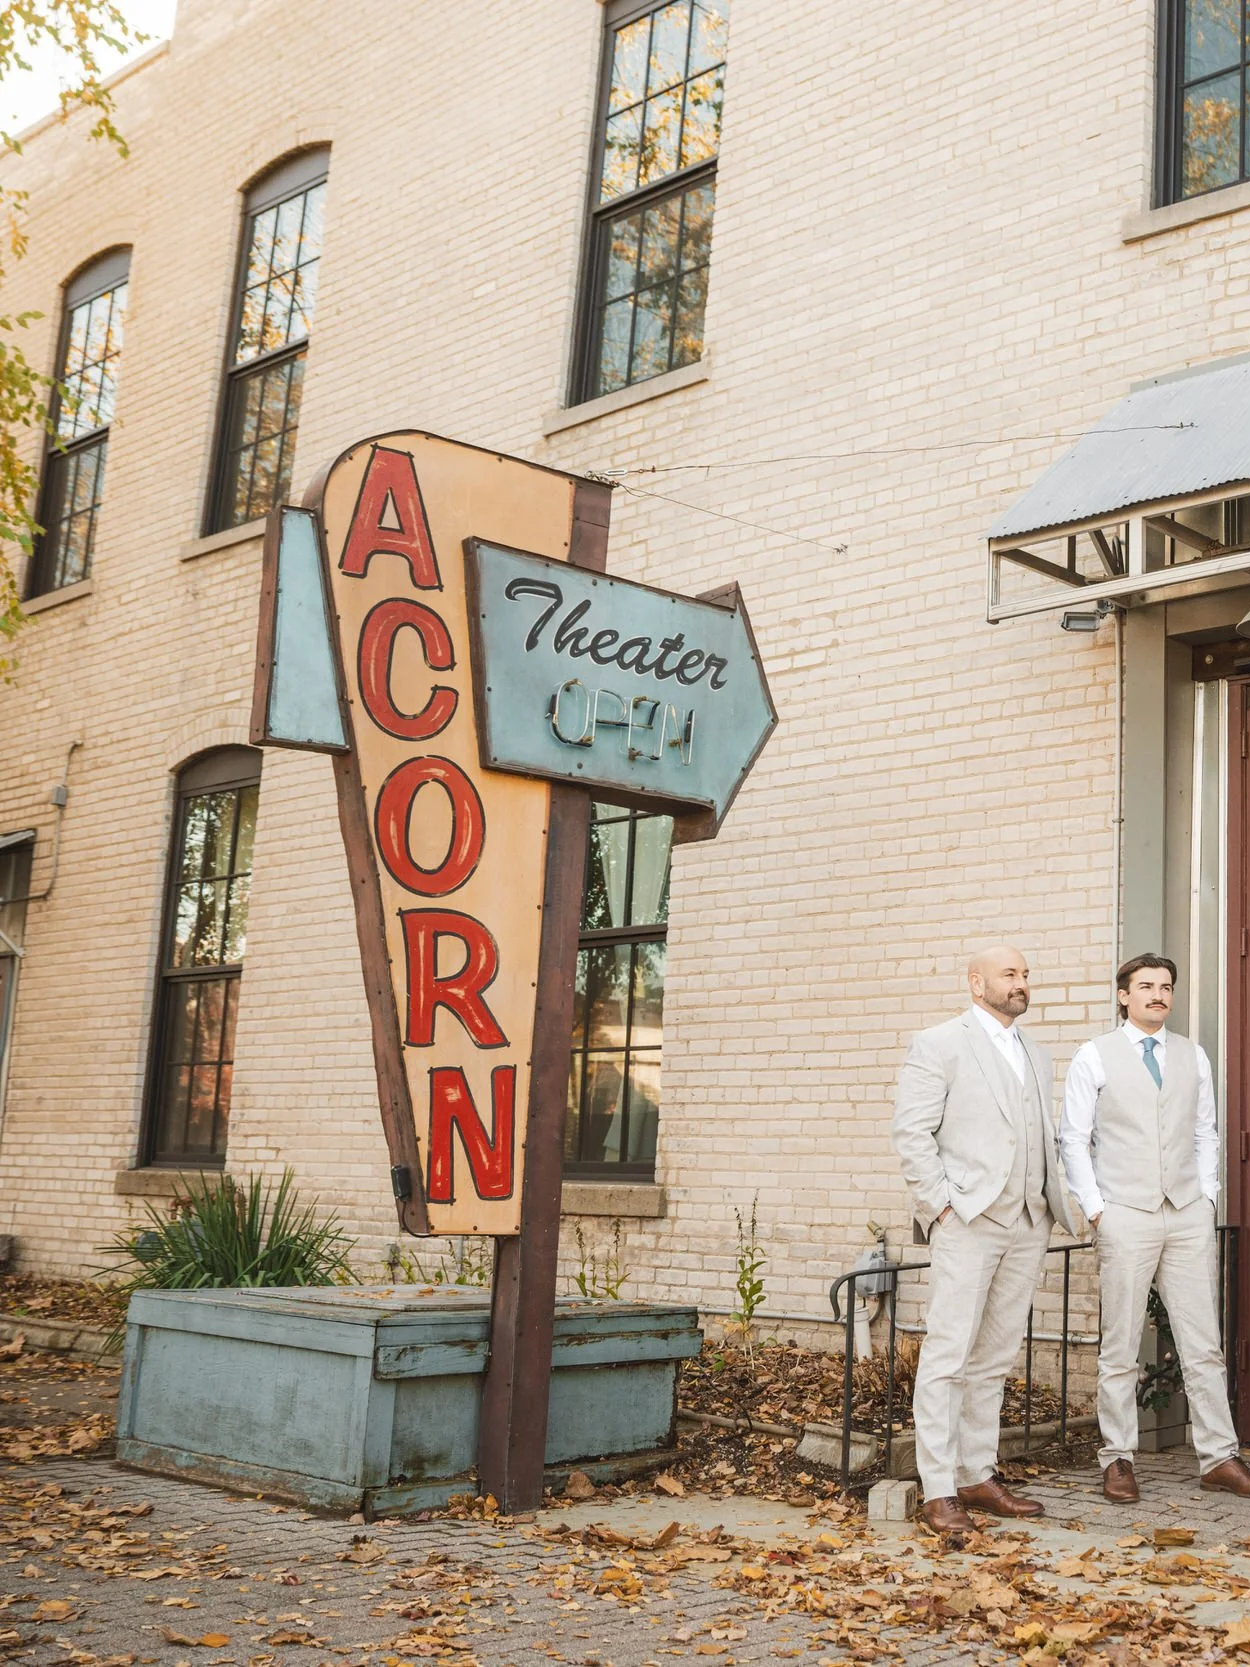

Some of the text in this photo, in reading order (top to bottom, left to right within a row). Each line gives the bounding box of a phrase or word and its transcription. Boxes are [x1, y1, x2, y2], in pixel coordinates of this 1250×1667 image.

[504, 576, 729, 691] Theater
[546, 677, 697, 766] OPEN
[338, 444, 519, 1205] ACORN
